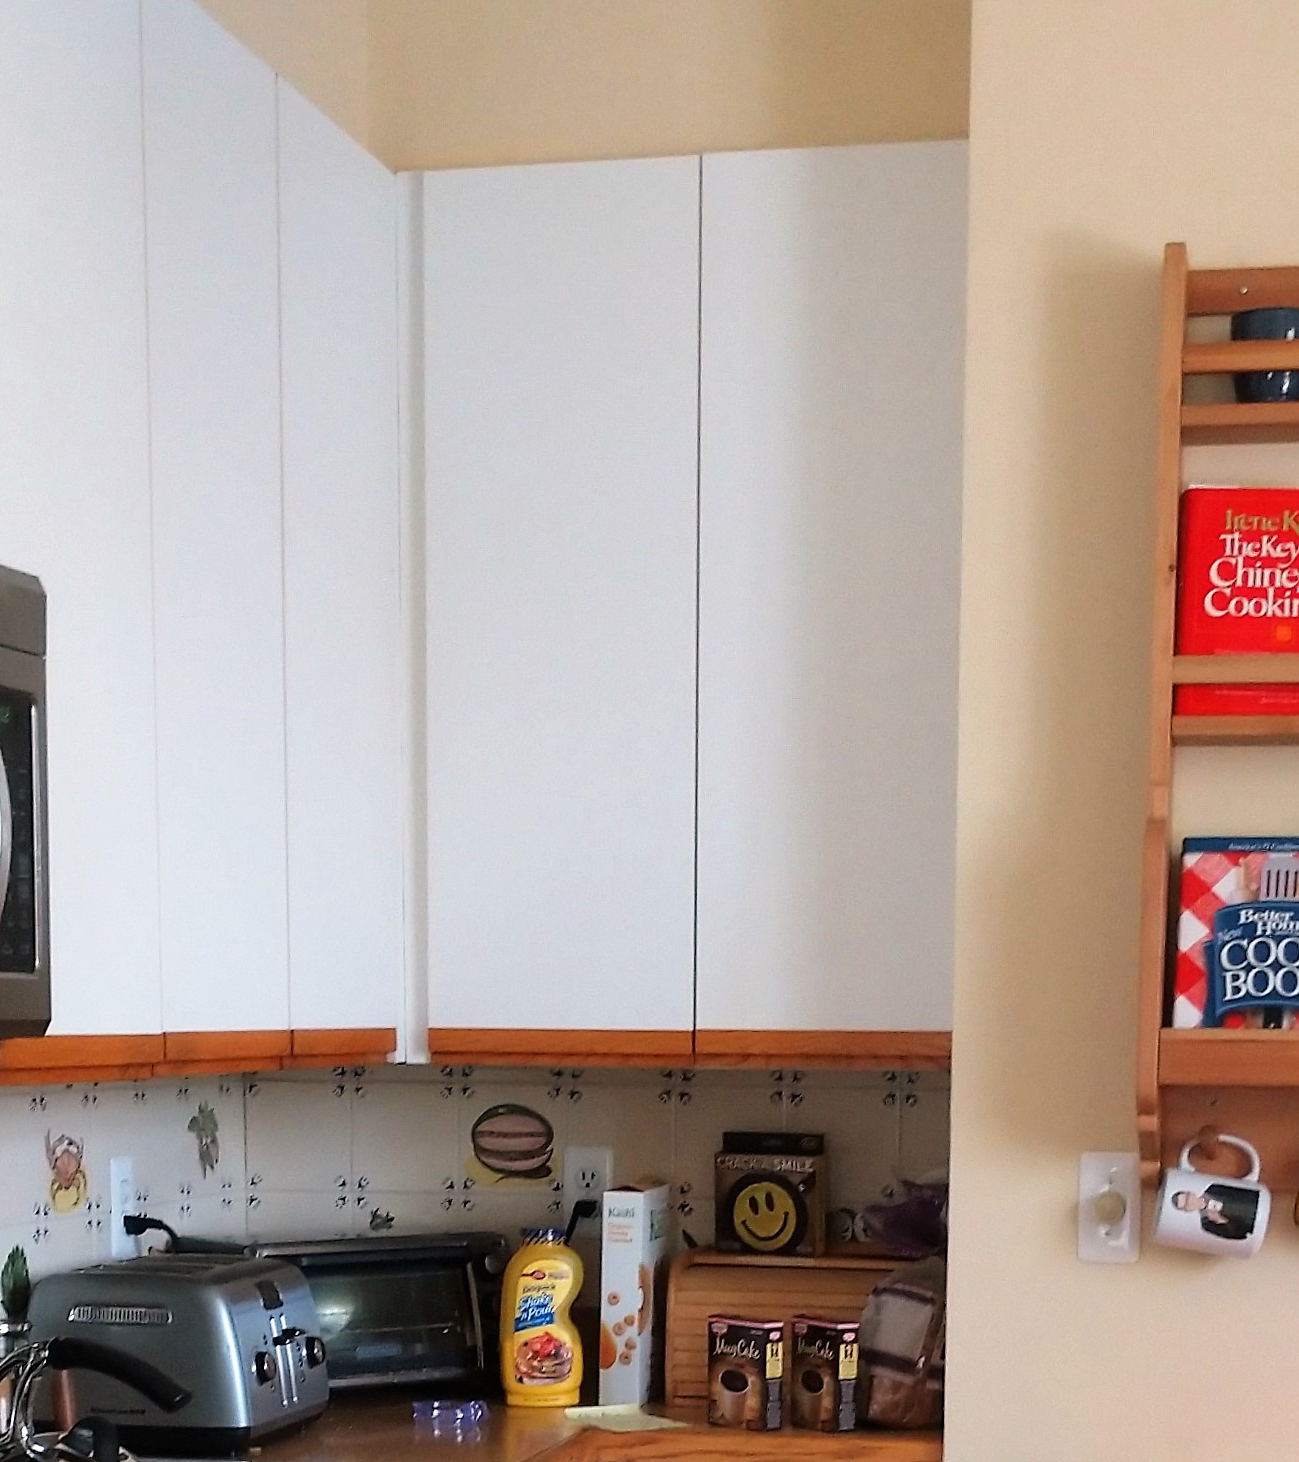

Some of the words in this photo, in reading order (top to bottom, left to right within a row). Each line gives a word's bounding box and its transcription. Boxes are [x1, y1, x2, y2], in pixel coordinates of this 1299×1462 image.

[1225, 509, 1281, 531] Irene
[1219, 532, 1261, 558] The
[1238, 909, 1294, 924] Better
[774, 1159, 814, 1172] SMILE
[713, 1336, 737, 1358] Mug
[737, 1339, 761, 1360] Cake
